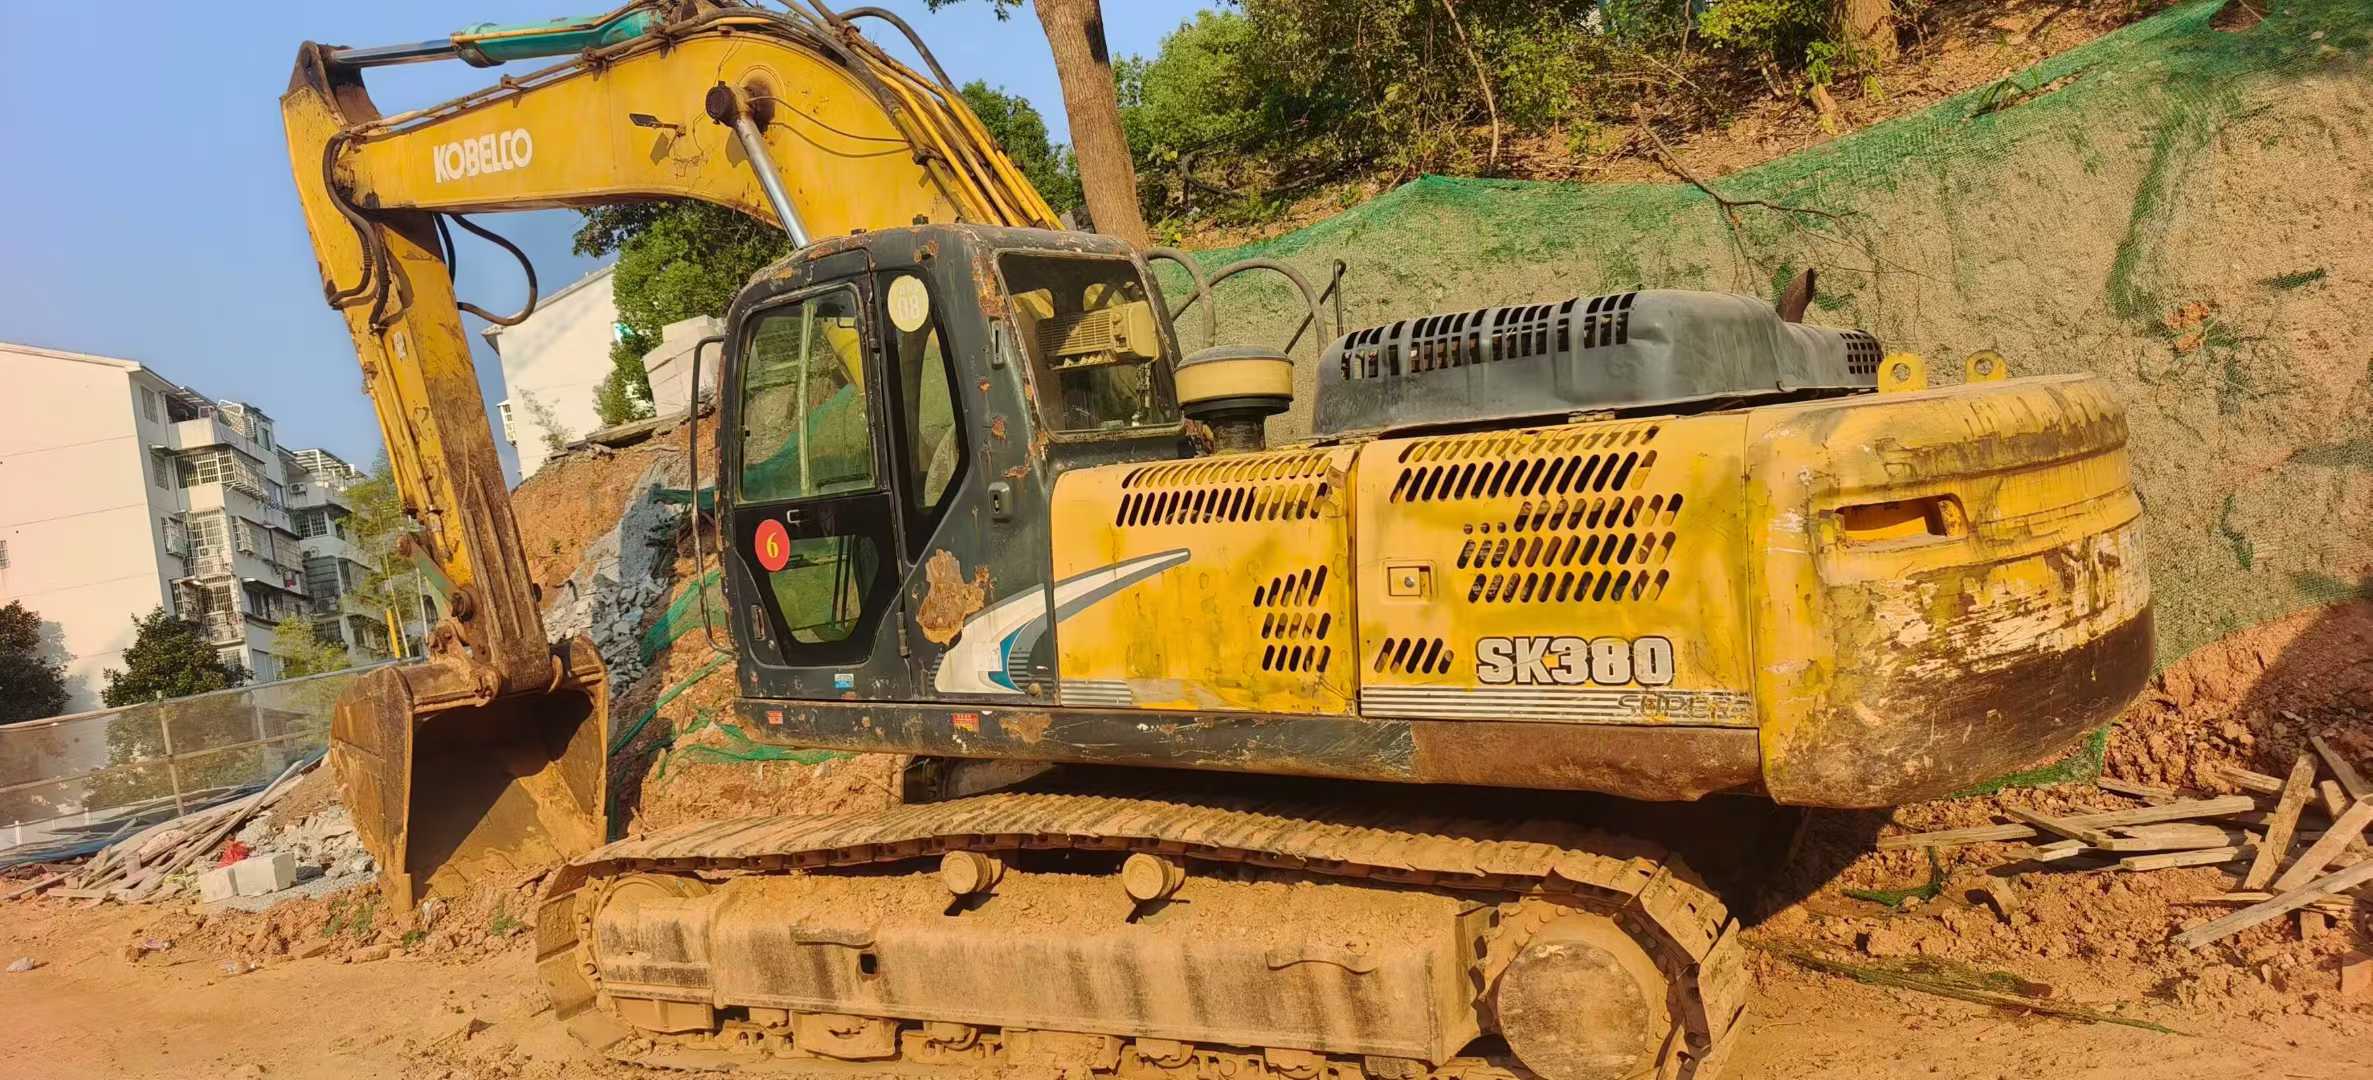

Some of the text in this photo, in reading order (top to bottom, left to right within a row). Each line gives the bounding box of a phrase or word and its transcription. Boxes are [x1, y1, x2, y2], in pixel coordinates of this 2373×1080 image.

[432, 128, 533, 184] KOBELCO
[766, 532, 780, 559] 6
[1476, 636, 1673, 686] SK380
